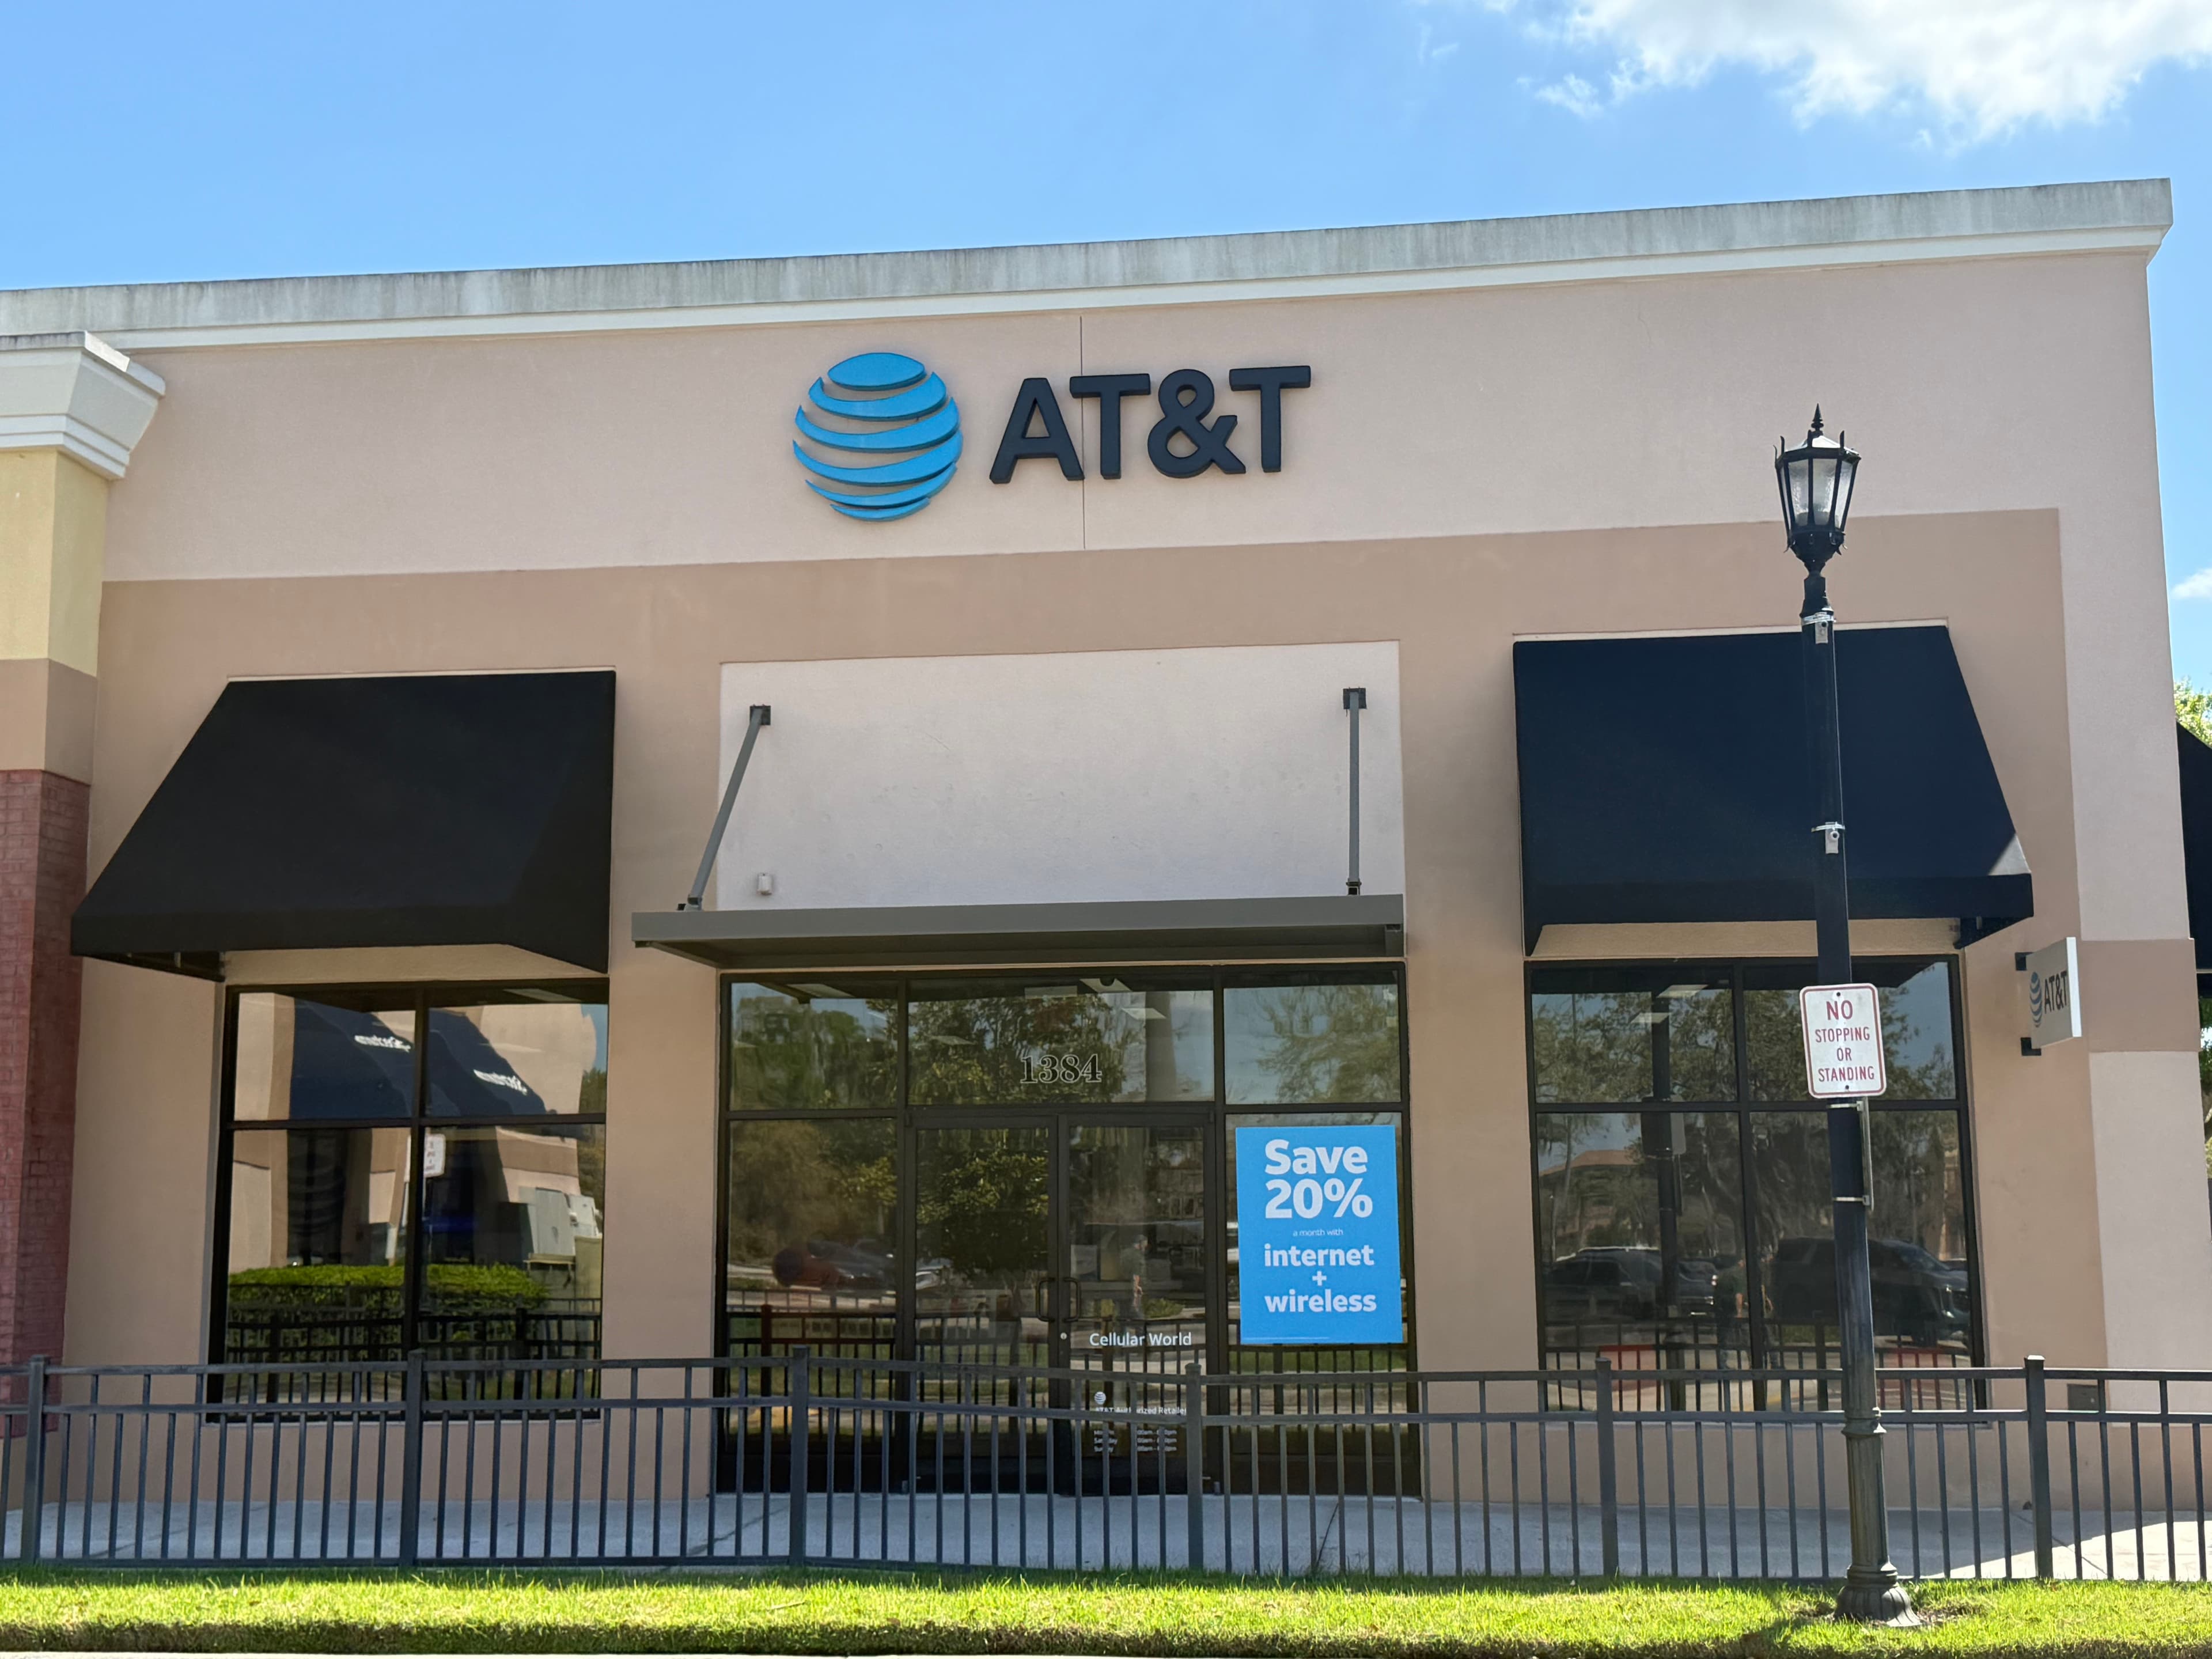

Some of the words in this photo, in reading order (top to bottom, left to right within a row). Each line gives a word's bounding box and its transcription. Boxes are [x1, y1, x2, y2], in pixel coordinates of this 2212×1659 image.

[989, 365, 1312, 484] AT&T
[2044, 970, 2067, 1014] AT&T
[1826, 1000, 1853, 1020] NO
[1815, 1027, 1870, 1043] STOPPING
[1836, 1047, 1852, 1061] OR
[1020, 1053, 1103, 1084] 1384
[1818, 1066, 1874, 1082] STANDING
[1264, 1138, 1369, 1175] Save
[1265, 1178, 1373, 1219] 20%
[1264, 1243, 1374, 1267] internet
[1264, 1289, 1377, 1313] wireless
[1089, 1332, 1145, 1346] Cellular
[1149, 1331, 1192, 1346] World
